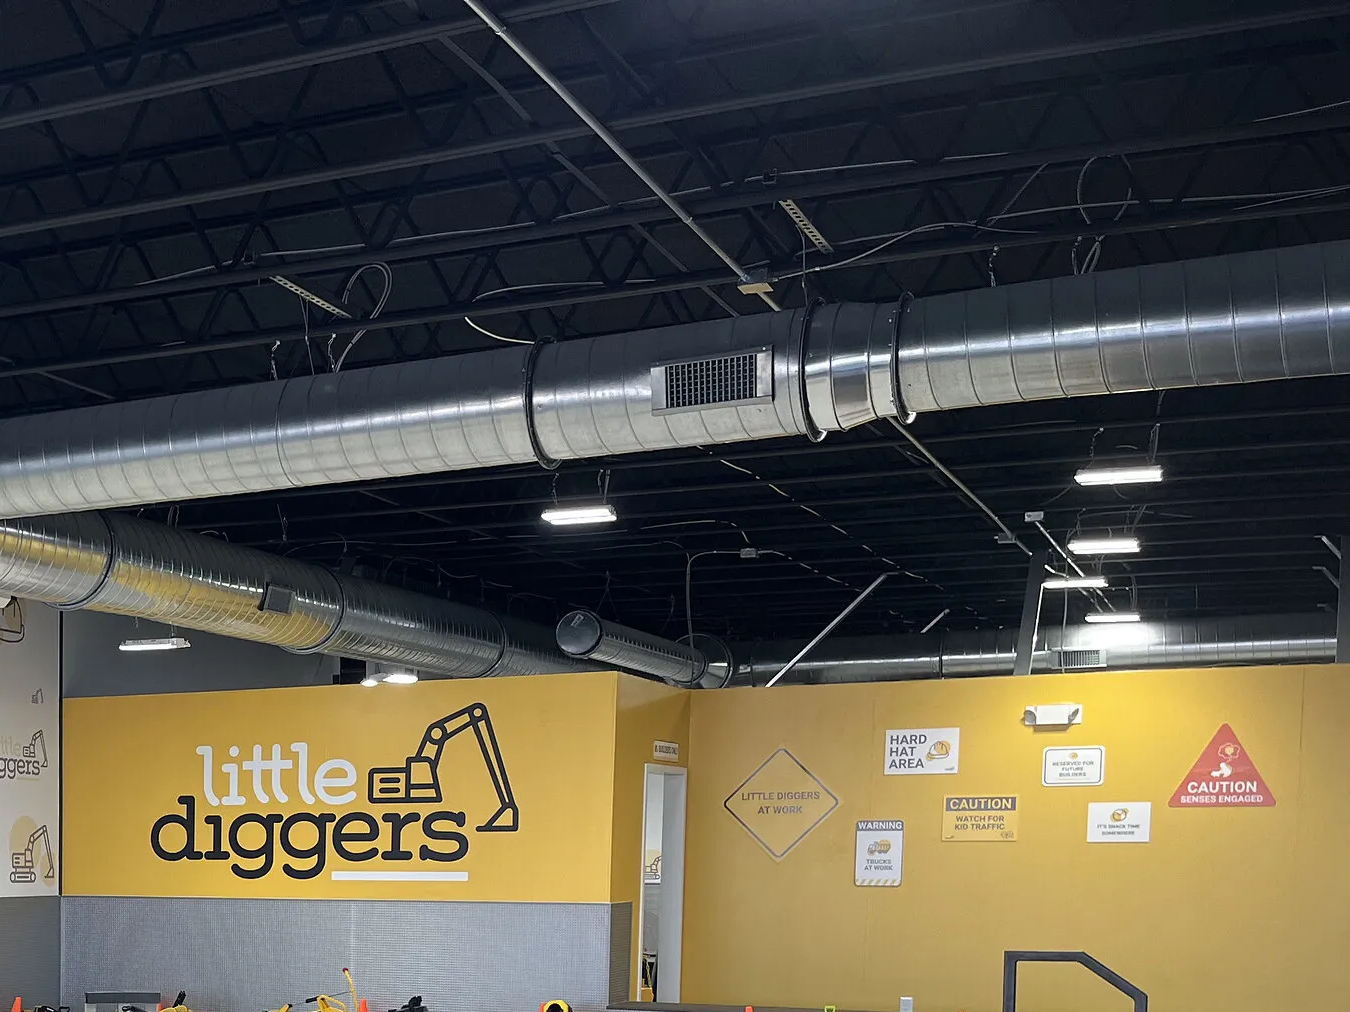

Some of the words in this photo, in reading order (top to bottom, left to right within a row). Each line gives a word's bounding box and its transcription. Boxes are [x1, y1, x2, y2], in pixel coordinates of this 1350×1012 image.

[890, 734, 927, 745] HARD
[889, 746, 917, 757] HAT
[888, 758, 925, 769] AREA
[196, 741, 359, 807] little
[1187, 781, 1257, 794] CAUTION
[741, 792, 775, 801] LITTLE
[777, 791, 821, 800] DIGGERS
[1180, 795, 1217, 804] SENSES
[1218, 794, 1263, 803] ENGAGED
[758, 806, 771, 814] AT
[773, 805, 803, 814] WORK
[950, 798, 1012, 810] CAUTION
[955, 815, 986, 823] WATCH
[987, 815, 1005, 823] FOR
[858, 821, 903, 830] WARNING
[954, 823, 968, 831] KID
[971, 823, 1005, 831] TRAFFIC
[150, 795, 470, 880] diggers
